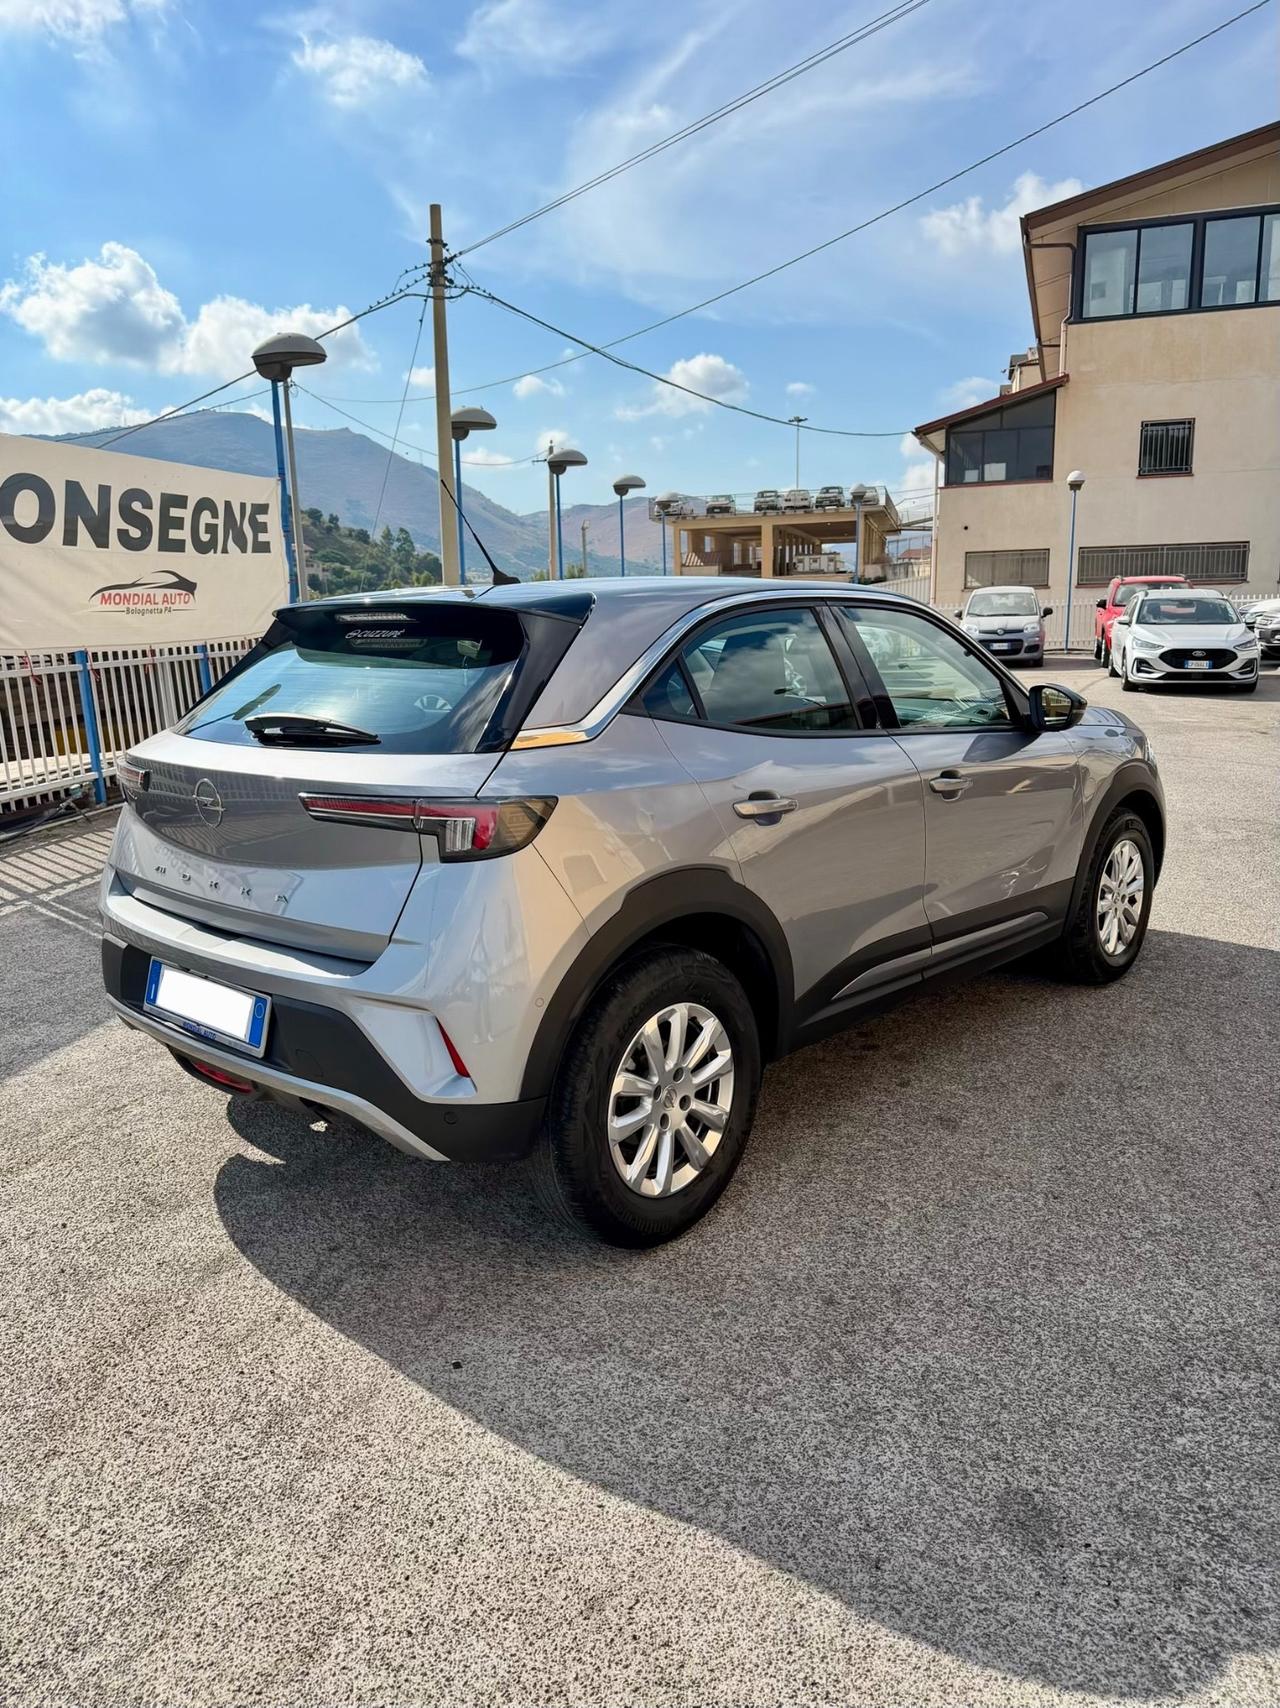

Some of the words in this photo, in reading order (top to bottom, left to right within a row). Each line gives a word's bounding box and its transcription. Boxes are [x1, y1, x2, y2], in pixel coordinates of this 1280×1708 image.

[100, 592, 159, 606] MONDIAL
[161, 593, 190, 606] AUTO
[125, 607, 163, 616] Bolognetta
[164, 606, 172, 614] PA
